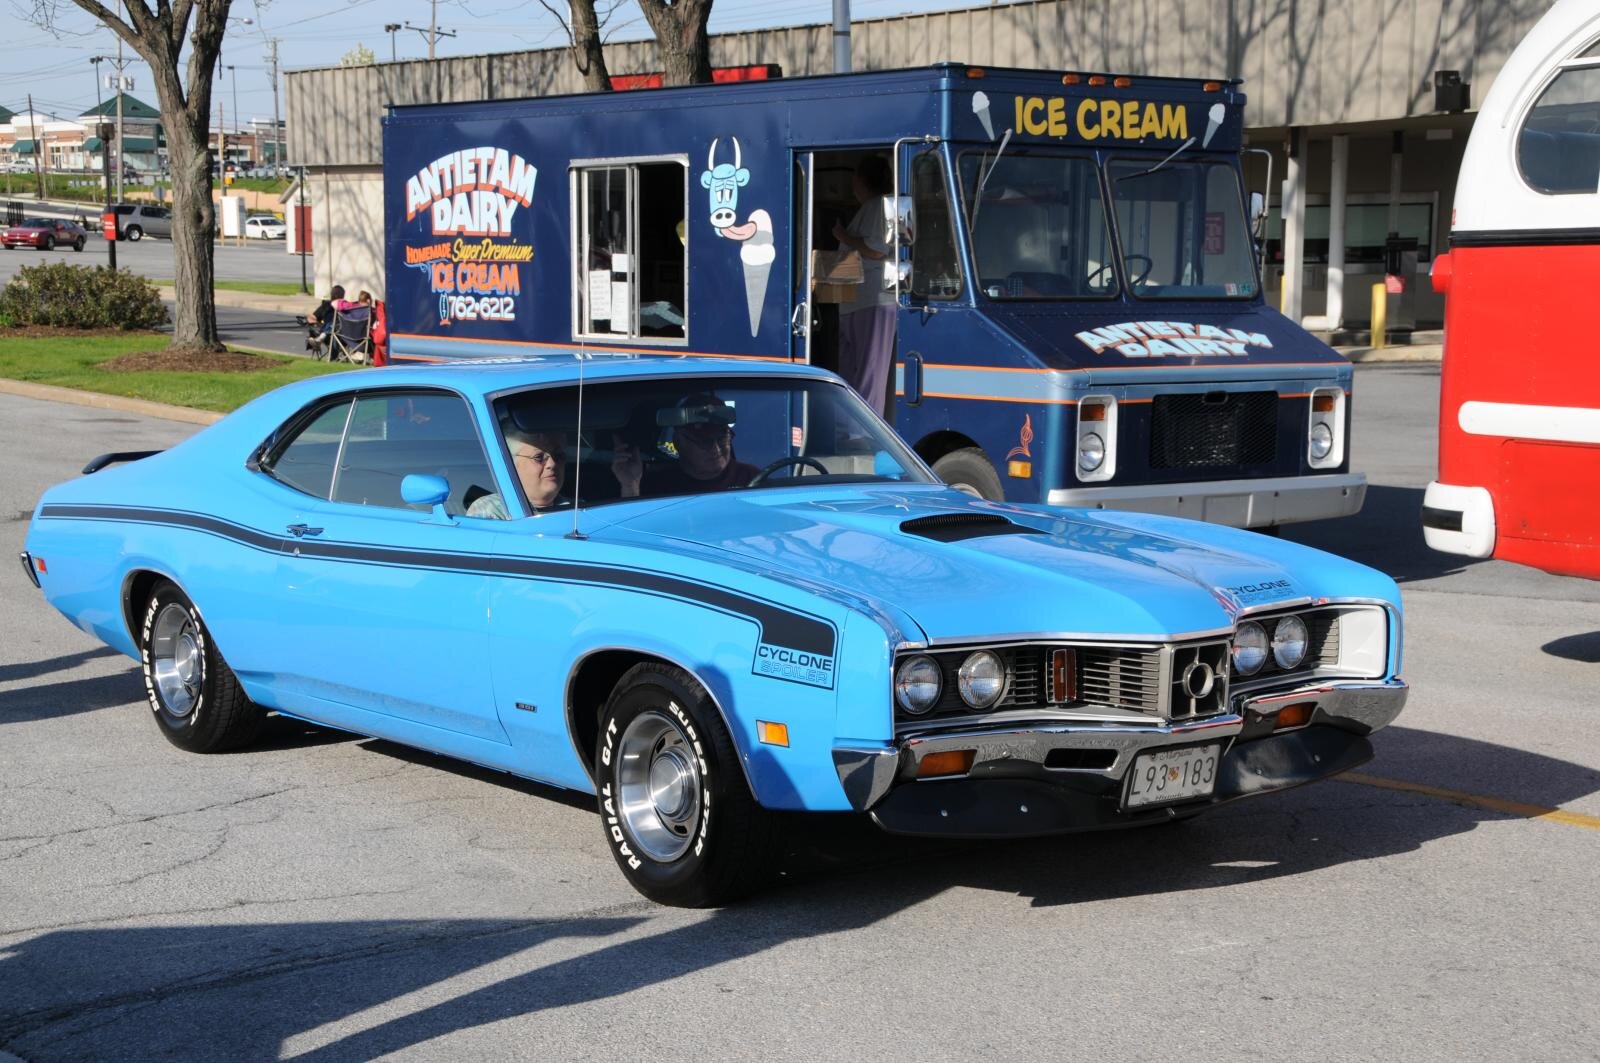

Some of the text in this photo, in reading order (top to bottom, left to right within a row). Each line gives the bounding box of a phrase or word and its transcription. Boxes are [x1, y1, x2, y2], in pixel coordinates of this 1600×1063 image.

[1015, 96, 1188, 140] ICE CREAM
[405, 147, 538, 222] ANTIETAM
[431, 190, 518, 237] DAIRY
[406, 238, 534, 264] HOMEMADE Super Premium
[431, 262, 520, 296] ICE CREAM
[1074, 321, 1273, 354] ANTIETAM
[1117, 337, 1249, 358] DAIRY
[1226, 580, 1291, 595] CYCLONE
[142, 597, 160, 712] SUPER STAR
[758, 645, 833, 672] CYCLONE
[761, 660, 828, 684] SPOILER
[601, 717, 642, 871] RADIAL G/T
[669, 701, 710, 857] SUPER STAR
